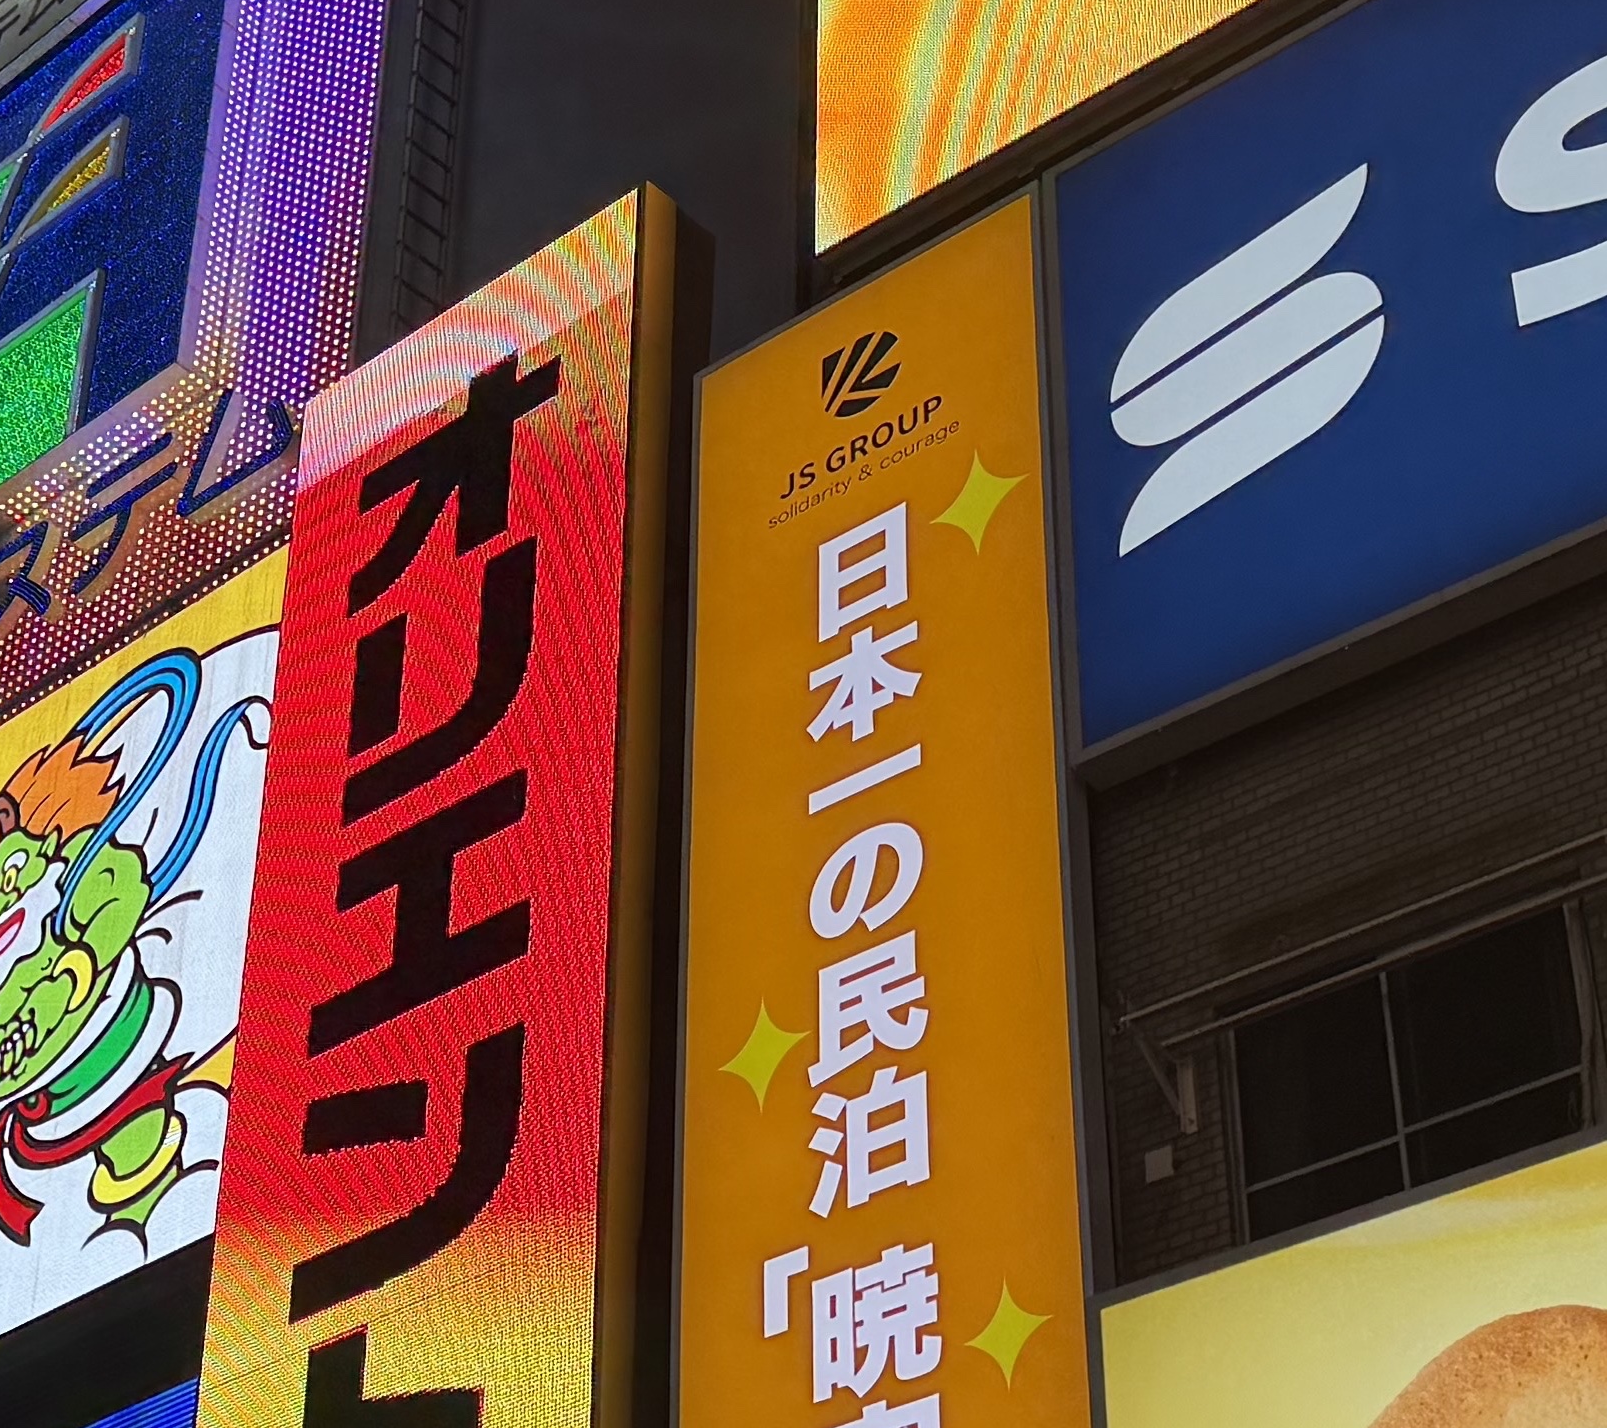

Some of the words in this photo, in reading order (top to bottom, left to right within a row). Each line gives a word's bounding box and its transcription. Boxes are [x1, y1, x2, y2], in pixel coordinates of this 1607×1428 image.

[768, 476, 852, 530] solidarity
[857, 462, 873, 482] &
[879, 419, 961, 470] courage
[779, 463, 817, 500] JS
[825, 394, 943, 472] GROUP
